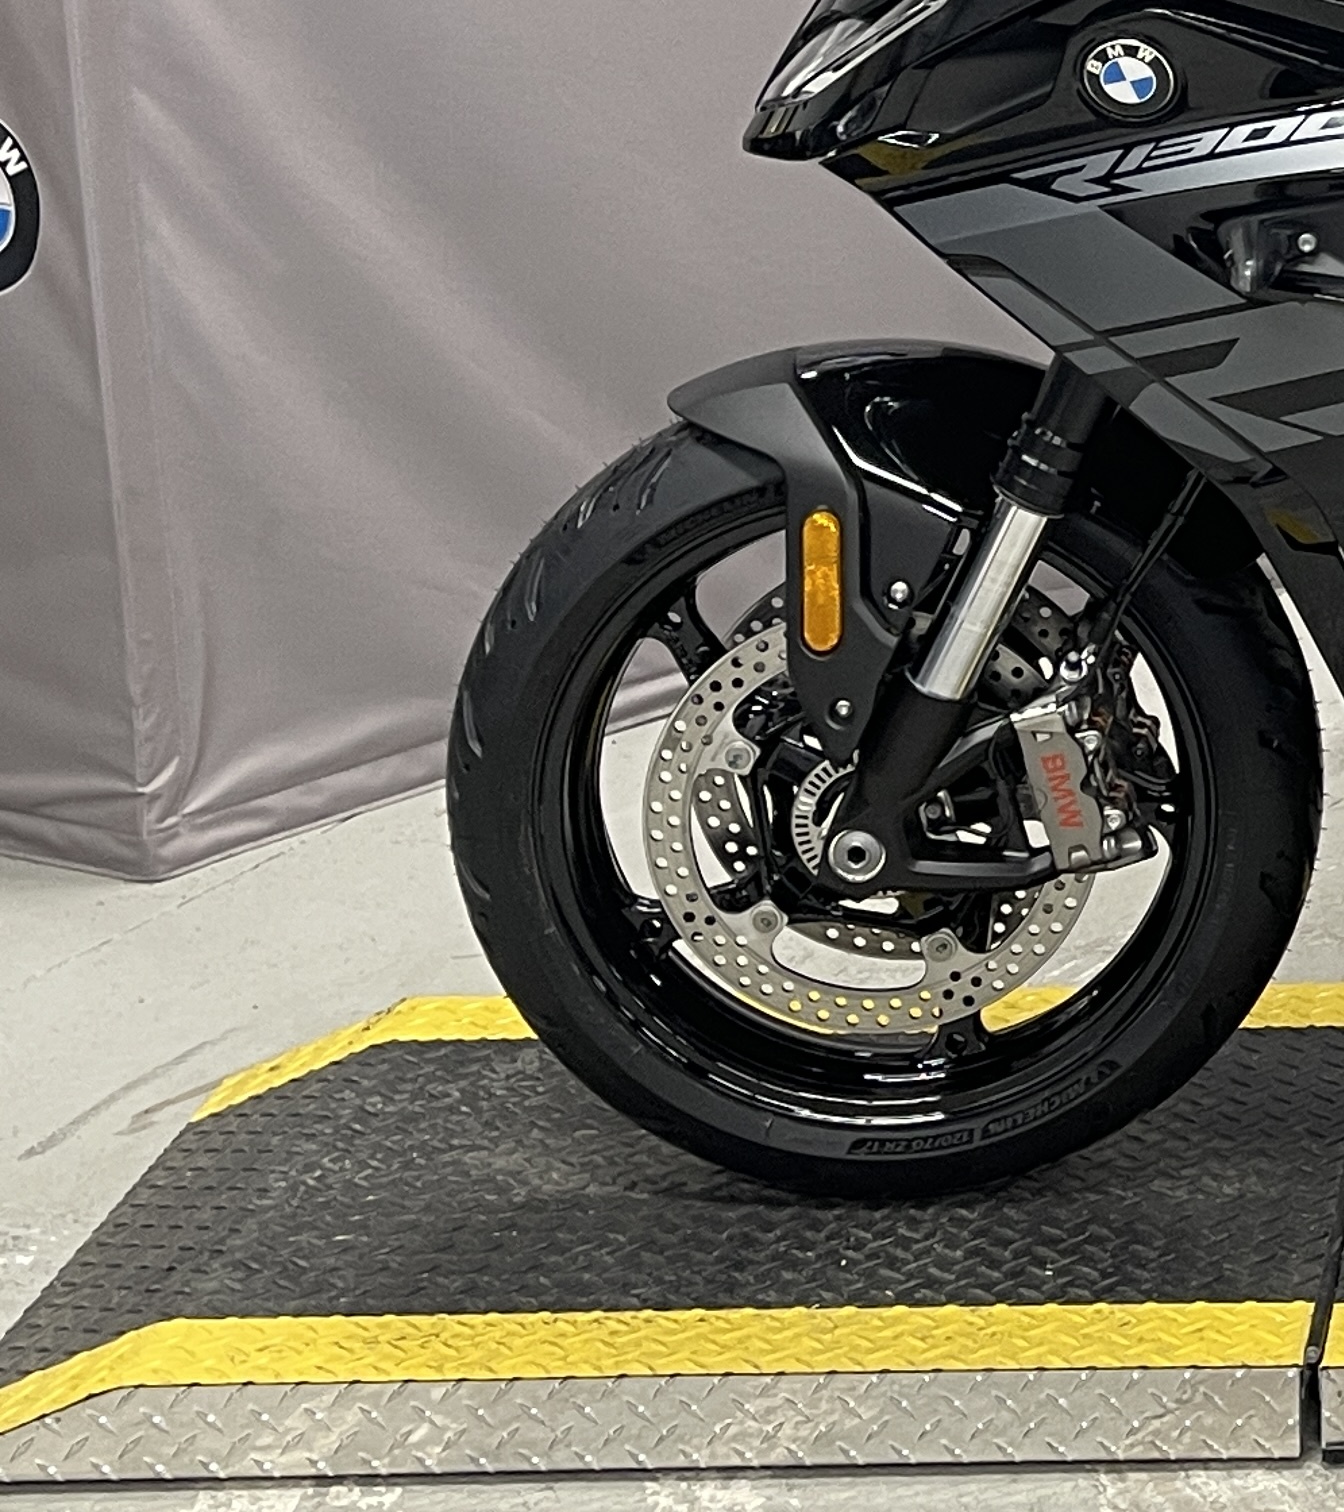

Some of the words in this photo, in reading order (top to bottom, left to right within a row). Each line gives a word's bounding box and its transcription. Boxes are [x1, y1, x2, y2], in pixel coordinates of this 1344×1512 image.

[1086, 44, 1156, 75] BMW
[1040, 752, 1085, 829] BMW
[987, 1078, 1087, 1134] MICHELIN
[913, 1129, 971, 1152] 120/70
